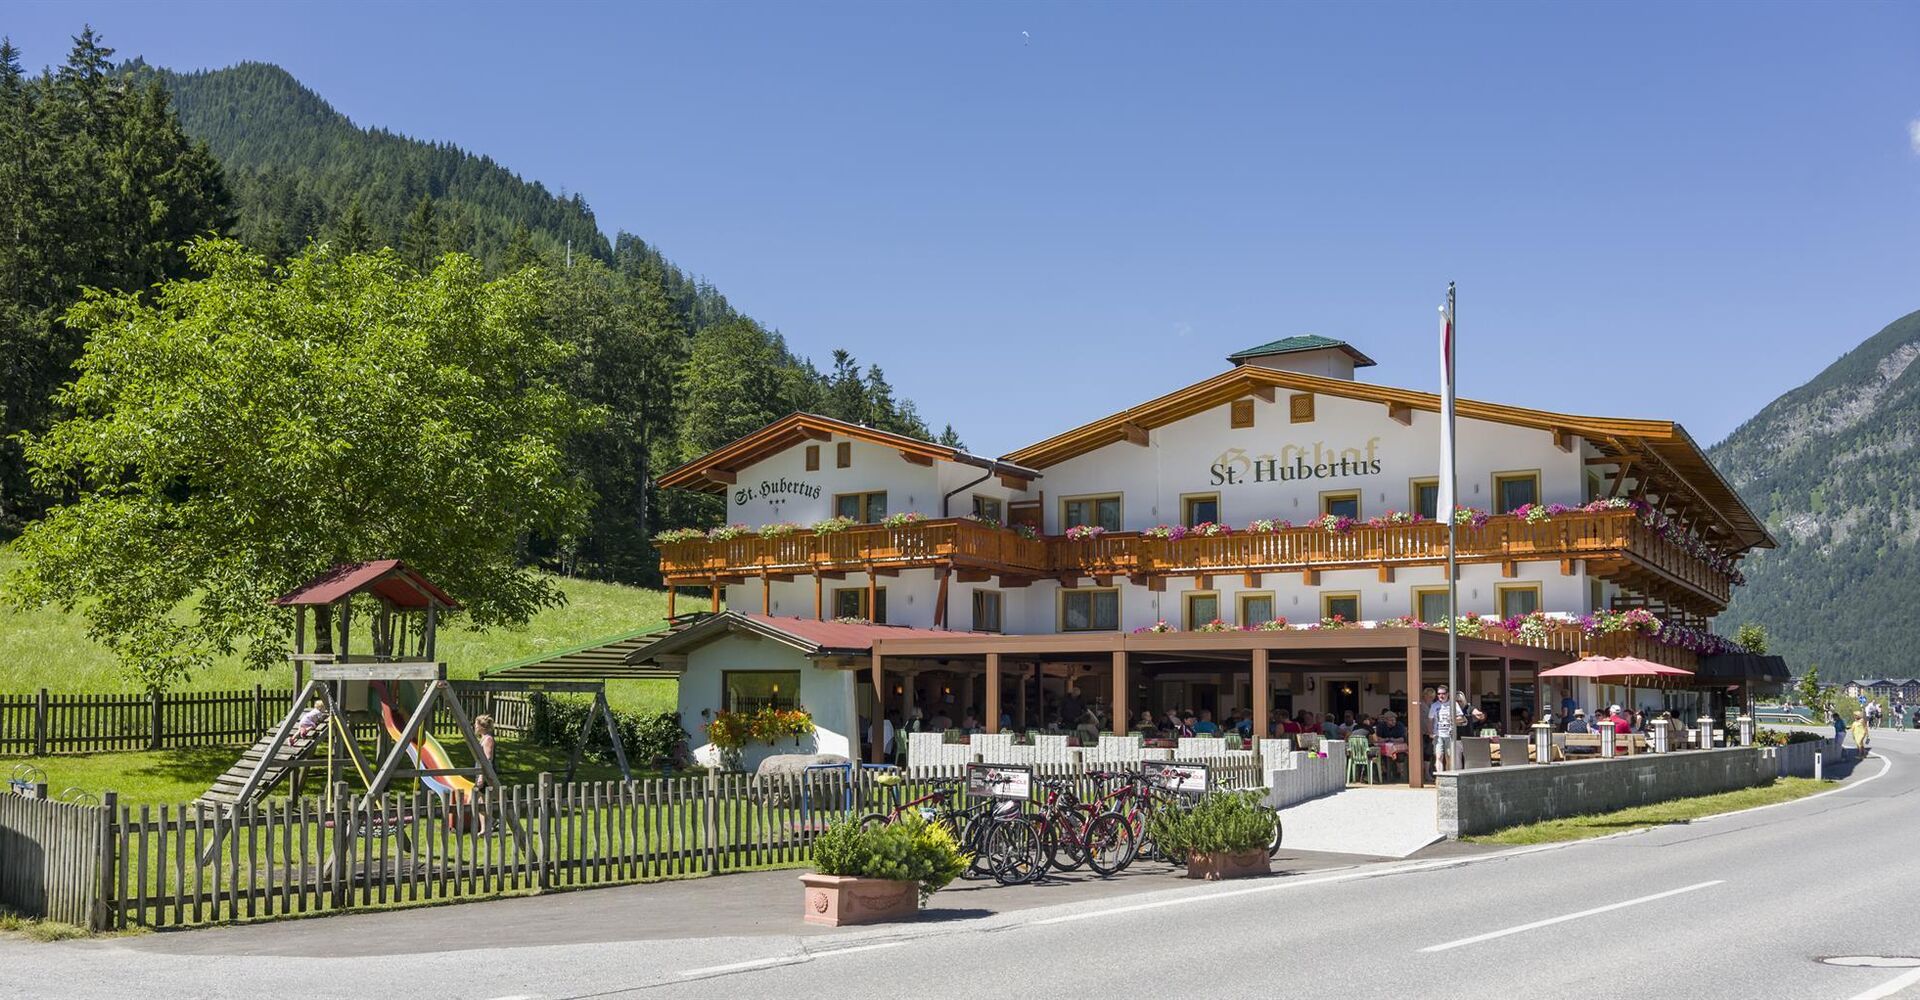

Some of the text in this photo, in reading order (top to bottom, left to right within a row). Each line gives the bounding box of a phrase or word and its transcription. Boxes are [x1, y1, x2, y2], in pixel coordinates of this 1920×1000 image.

[1210, 457, 1381, 486] St. Hubertus
[735, 477, 822, 505] St. Hubertus
